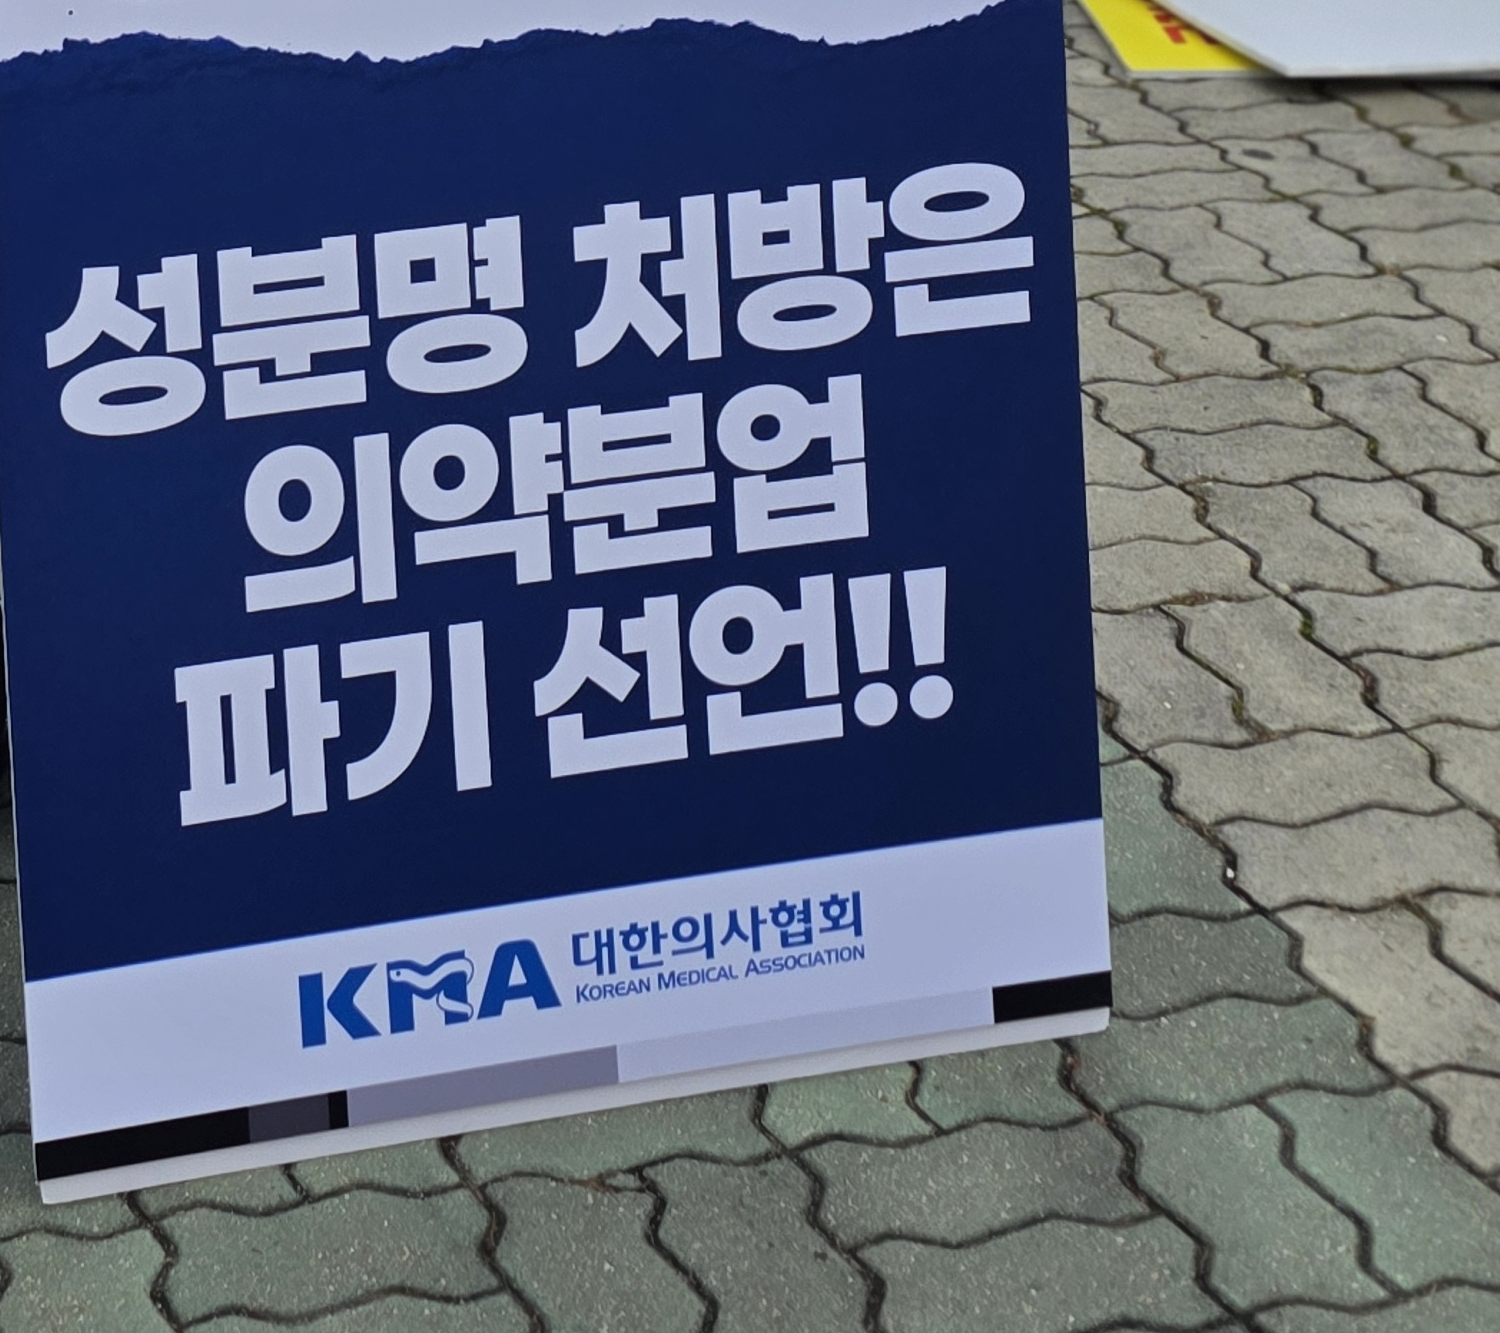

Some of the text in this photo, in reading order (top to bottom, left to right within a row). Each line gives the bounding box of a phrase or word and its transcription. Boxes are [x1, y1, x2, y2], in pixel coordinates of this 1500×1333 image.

[46, 163, 1034, 436] 성분명 처방은
[245, 374, 869, 612] 의약분업
[174, 566, 953, 826] 파기 선언!!
[299, 940, 561, 1048] KMA
[572, 891, 862, 976] 대한의사협회
[577, 946, 864, 1003] KOREAN MEDICAL ASSOCIATION
